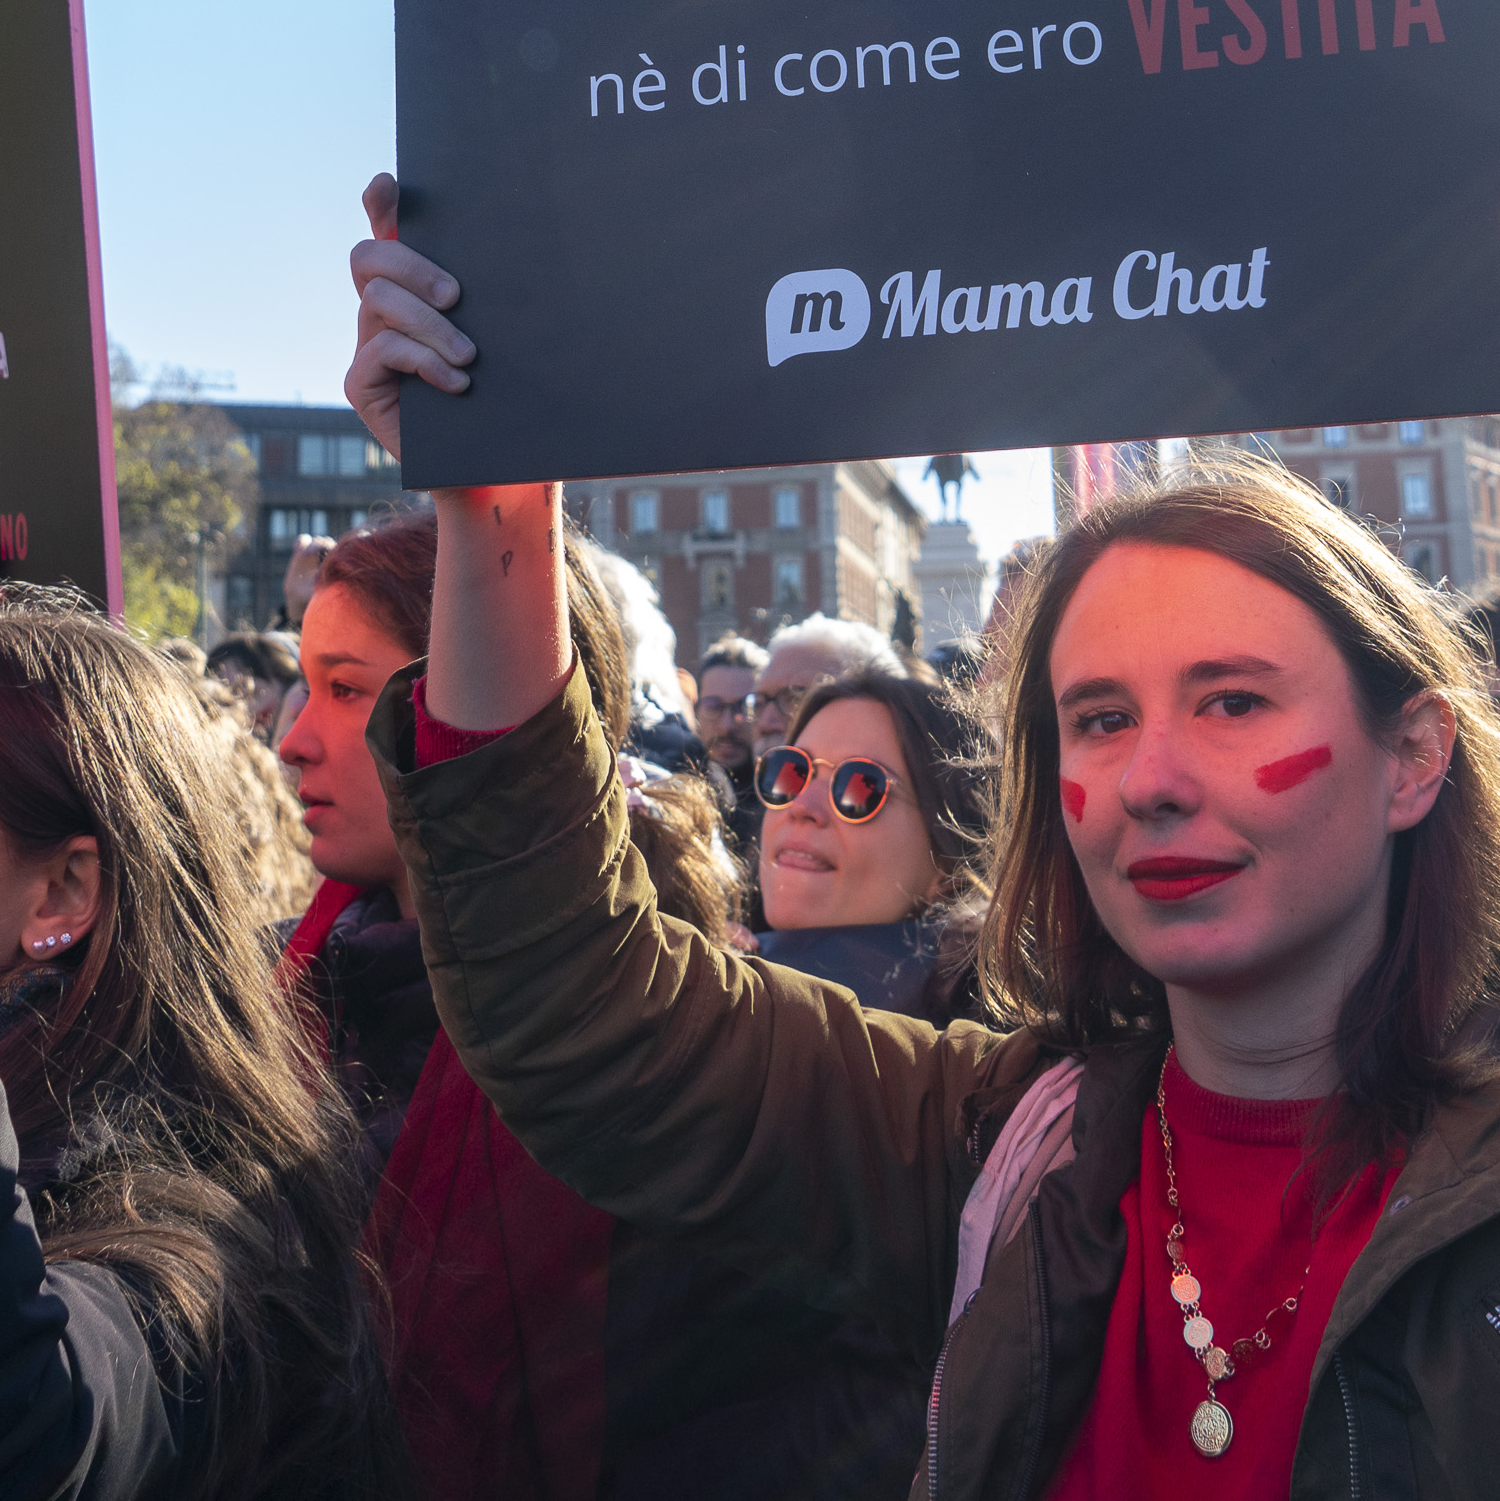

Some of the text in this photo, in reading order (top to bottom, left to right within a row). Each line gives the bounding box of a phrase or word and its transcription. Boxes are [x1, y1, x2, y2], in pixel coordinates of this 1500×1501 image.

[590, 52, 666, 117] nè
[691, 42, 748, 107] di
[774, 41, 961, 97] come
[987, 21, 1104, 74] ero
[879, 269, 1095, 340] Mama
[1112, 246, 1271, 321] Chat
